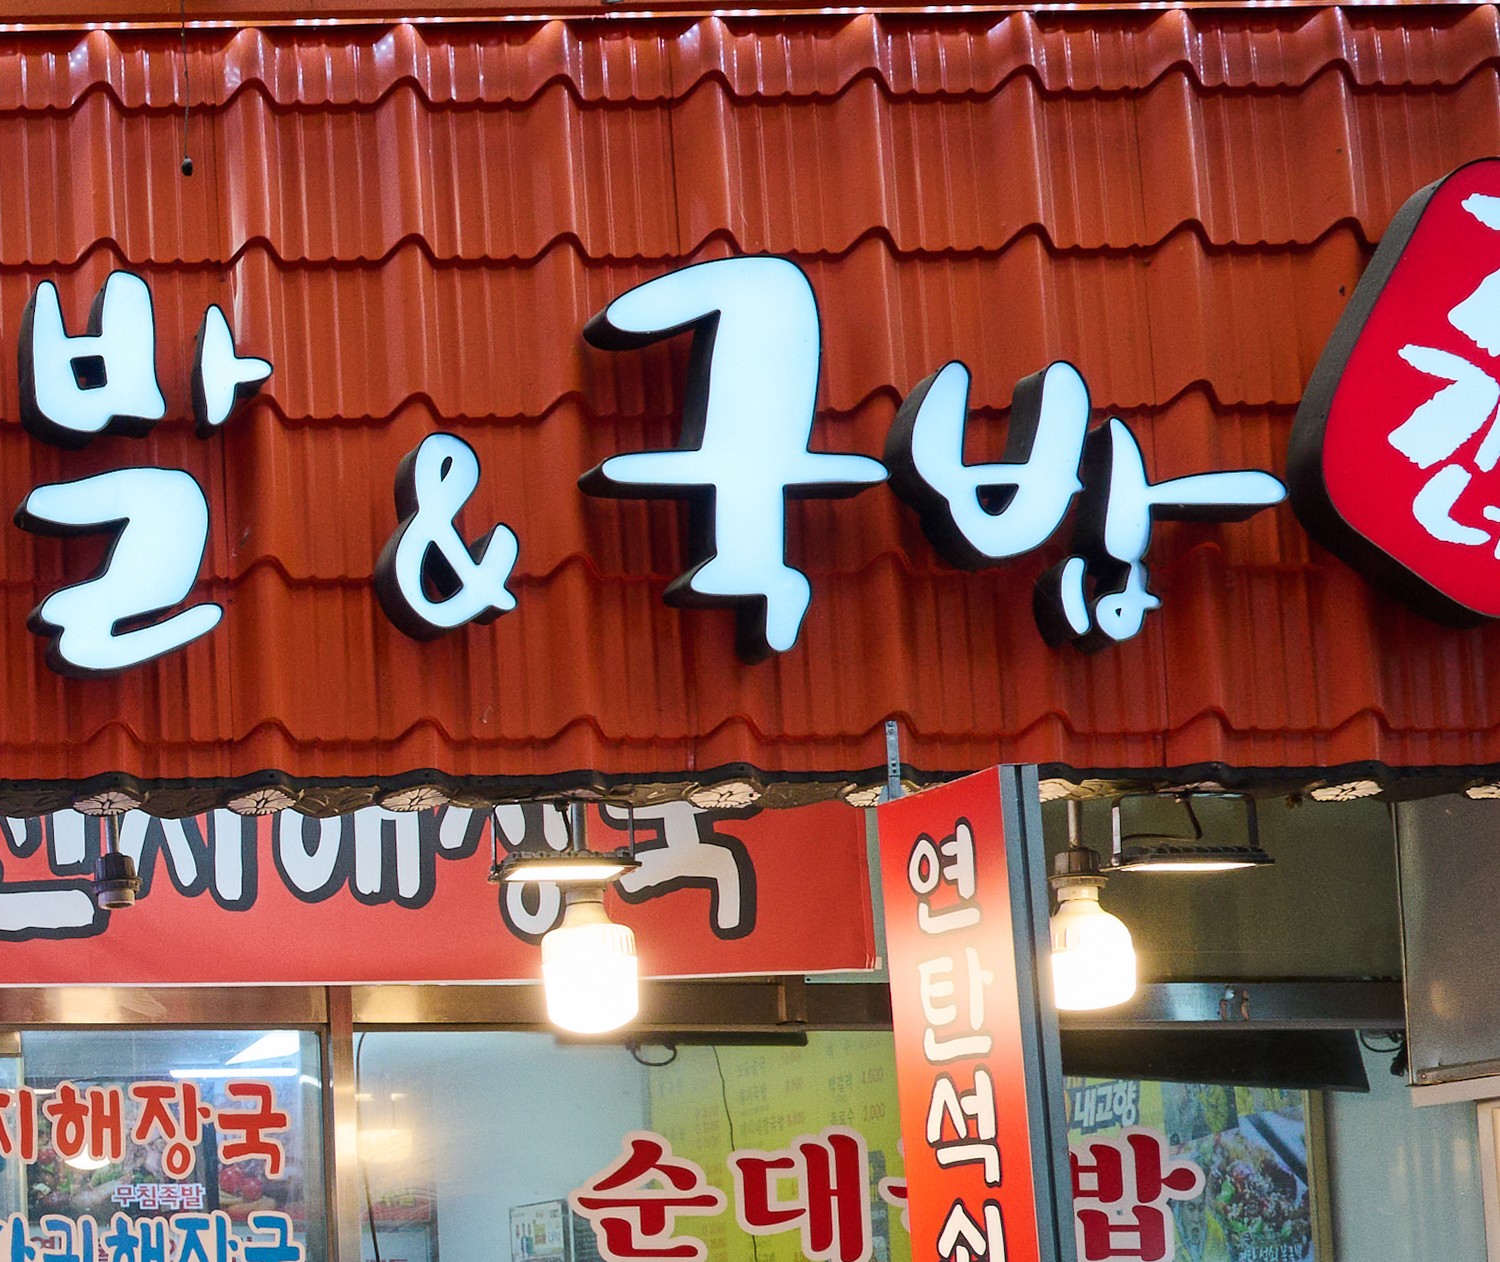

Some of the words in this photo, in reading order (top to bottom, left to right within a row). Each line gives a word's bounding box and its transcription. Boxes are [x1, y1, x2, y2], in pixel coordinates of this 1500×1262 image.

[382, 432, 520, 640] &
[588, 255, 1290, 652] 국밥
[114, 1185, 206, 1208] 무침족발
[578, 1131, 1197, 1262] 순대밥
